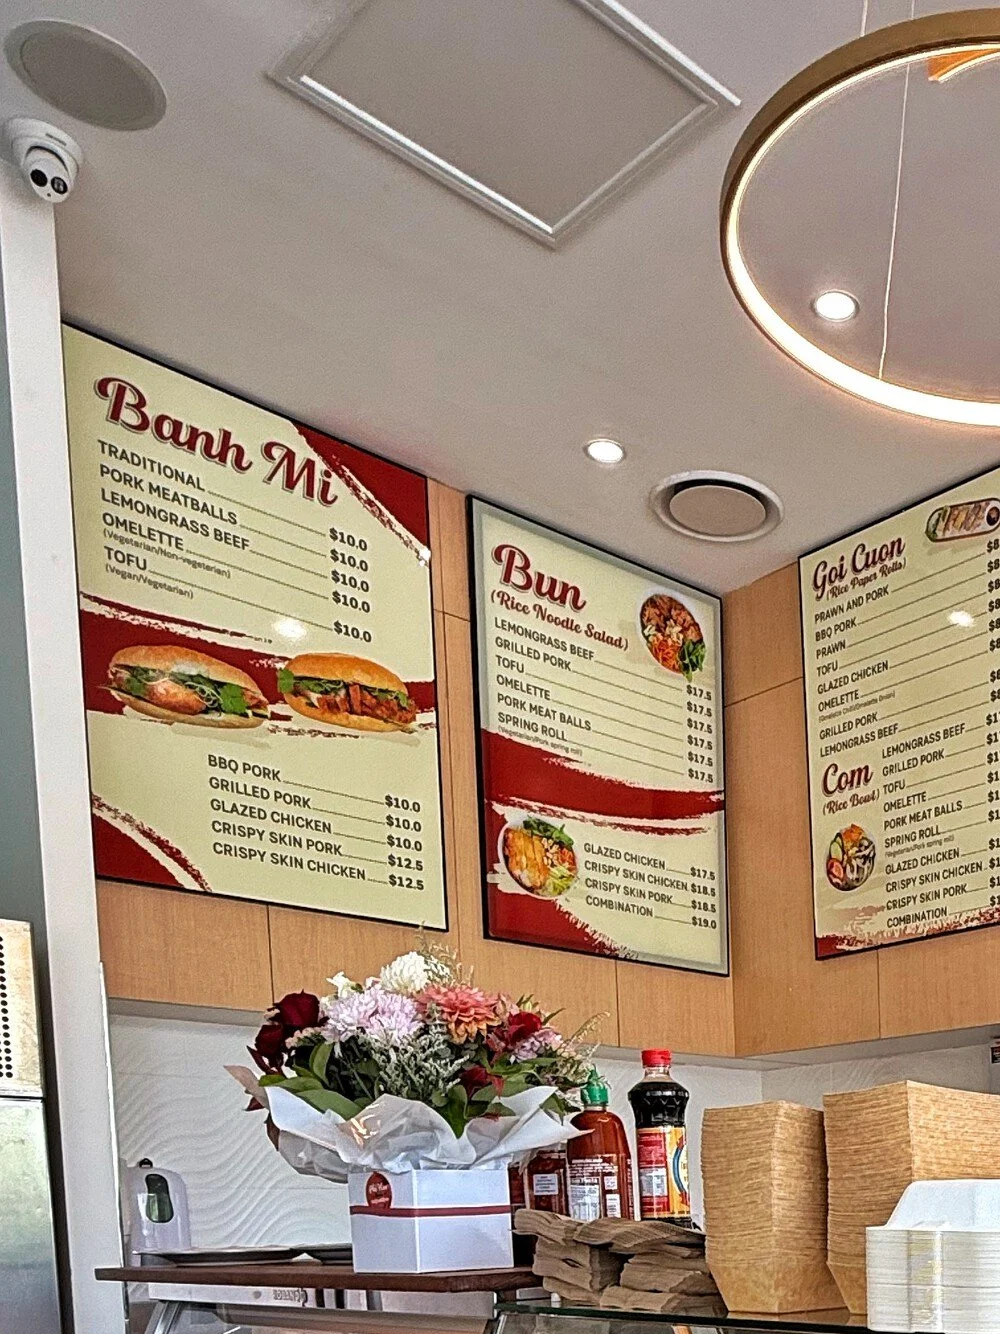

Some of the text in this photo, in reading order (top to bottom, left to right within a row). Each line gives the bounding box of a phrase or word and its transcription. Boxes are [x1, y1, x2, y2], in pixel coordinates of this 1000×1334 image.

[94, 377, 338, 507] Banh Mi
[96, 438, 367, 551] TRADITIONAL $10.0
[99, 463, 368, 571] PORK MEATBALLS $10.0
[100, 487, 369, 592] LEMONGRASS BEEF $10.0
[102, 512, 370, 613] OMELETTE $10.0
[105, 562, 193, 599] (Vegan/Vegetarian)
[492, 544, 586, 612] Bun
[813, 537, 905, 601] Goi Cuon
[103, 545, 371, 642] TOFU $10.0
[814, 604, 844, 624] PRAWN
[845, 595, 863, 611] AND
[865, 584, 888, 603] PORK
[826, 584, 848, 601] (Rice
[490, 589, 628, 651] (Rice Noodle Salad)
[494, 616, 711, 700] LEMONGRASS BEEF $17.5
[816, 659, 838, 677] TOFU
[495, 654, 712, 734] TOFU $17.5
[817, 689, 859, 712] OMELETTE
[497, 711, 713, 783] SPRING ROLL $17.5
[819, 730, 875, 757] LEMONGRASS
[877, 722, 898, 739] BEEF
[881, 730, 941, 758] LEMONGRASS
[942, 722, 965, 739] BEEF
[207, 754, 420, 812] BBQ PORK $10.0
[822, 763, 873, 797] Com
[822, 800, 848, 815] (Rice
[883, 790, 926, 812] OMELETTE
[211, 820, 423, 871] CRISPY SKIN PORK $12.5
[884, 831, 916, 848] SPRING
[918, 824, 941, 839] ROLL
[212, 841, 424, 890] CRISPY SKIN CHICKEN $12.5
[583, 842, 715, 880] GLAZED CHICKEN $17.5
[584, 859, 715, 897] CRISPY SKIN CHICKEN $18.5
[884, 857, 918, 875] GLAZED
[920, 847, 959, 866] CHICKEN
[885, 876, 916, 892] CRISPY
[918, 871, 940, 885] SKIN
[941, 860, 982, 879] CHICKEN
[585, 894, 716, 929] COMBINATION $19.0
[886, 906, 947, 928] COMBINATION
